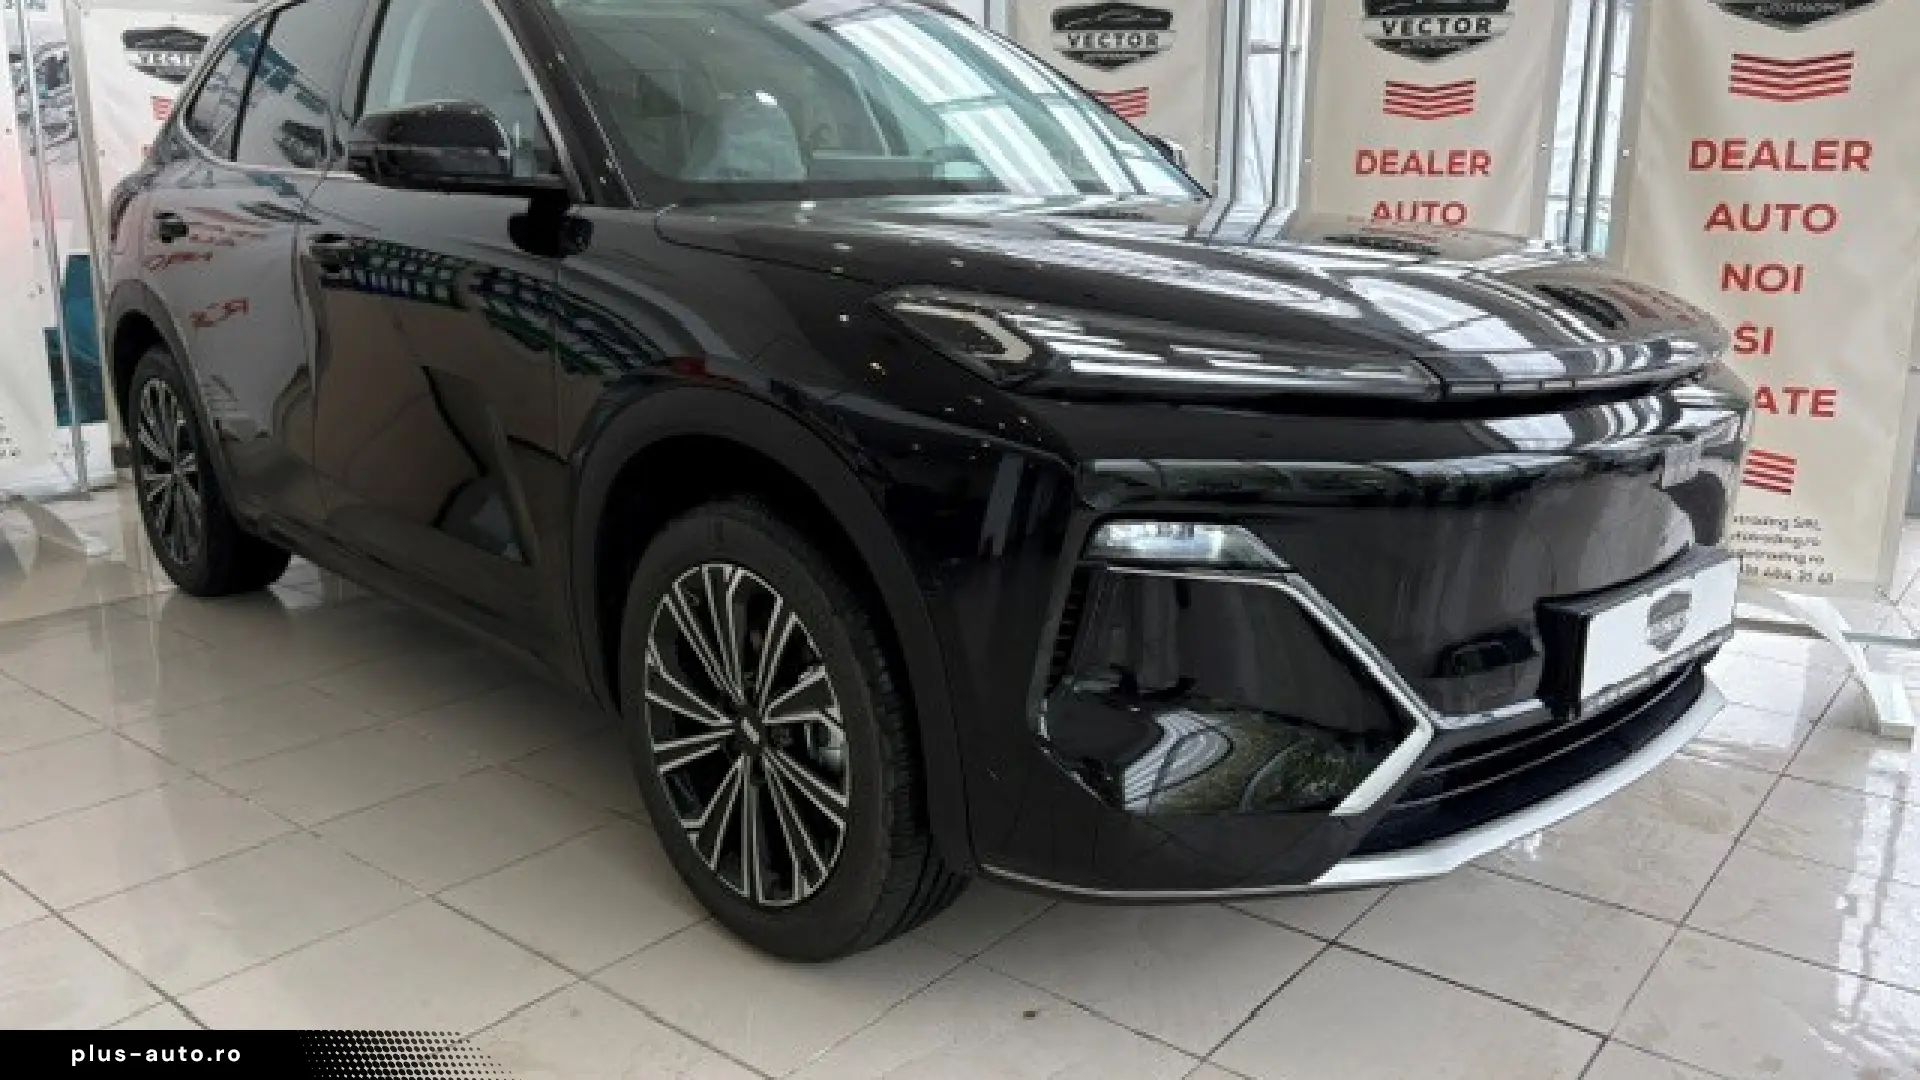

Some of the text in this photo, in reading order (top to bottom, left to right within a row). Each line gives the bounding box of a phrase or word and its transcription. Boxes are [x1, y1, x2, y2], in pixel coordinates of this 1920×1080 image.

[1066, 32, 1159, 48] VECTOR
[1382, 17, 1491, 36] VECTOR
[1355, 149, 1492, 177] DEALER
[1689, 139, 1873, 172] DEALER
[1371, 200, 1467, 226] AUTO
[1704, 203, 1838, 233] AUTO
[1721, 264, 1804, 294] NOI
[1732, 322, 1773, 355] SI
[1753, 386, 1837, 417] ATE
